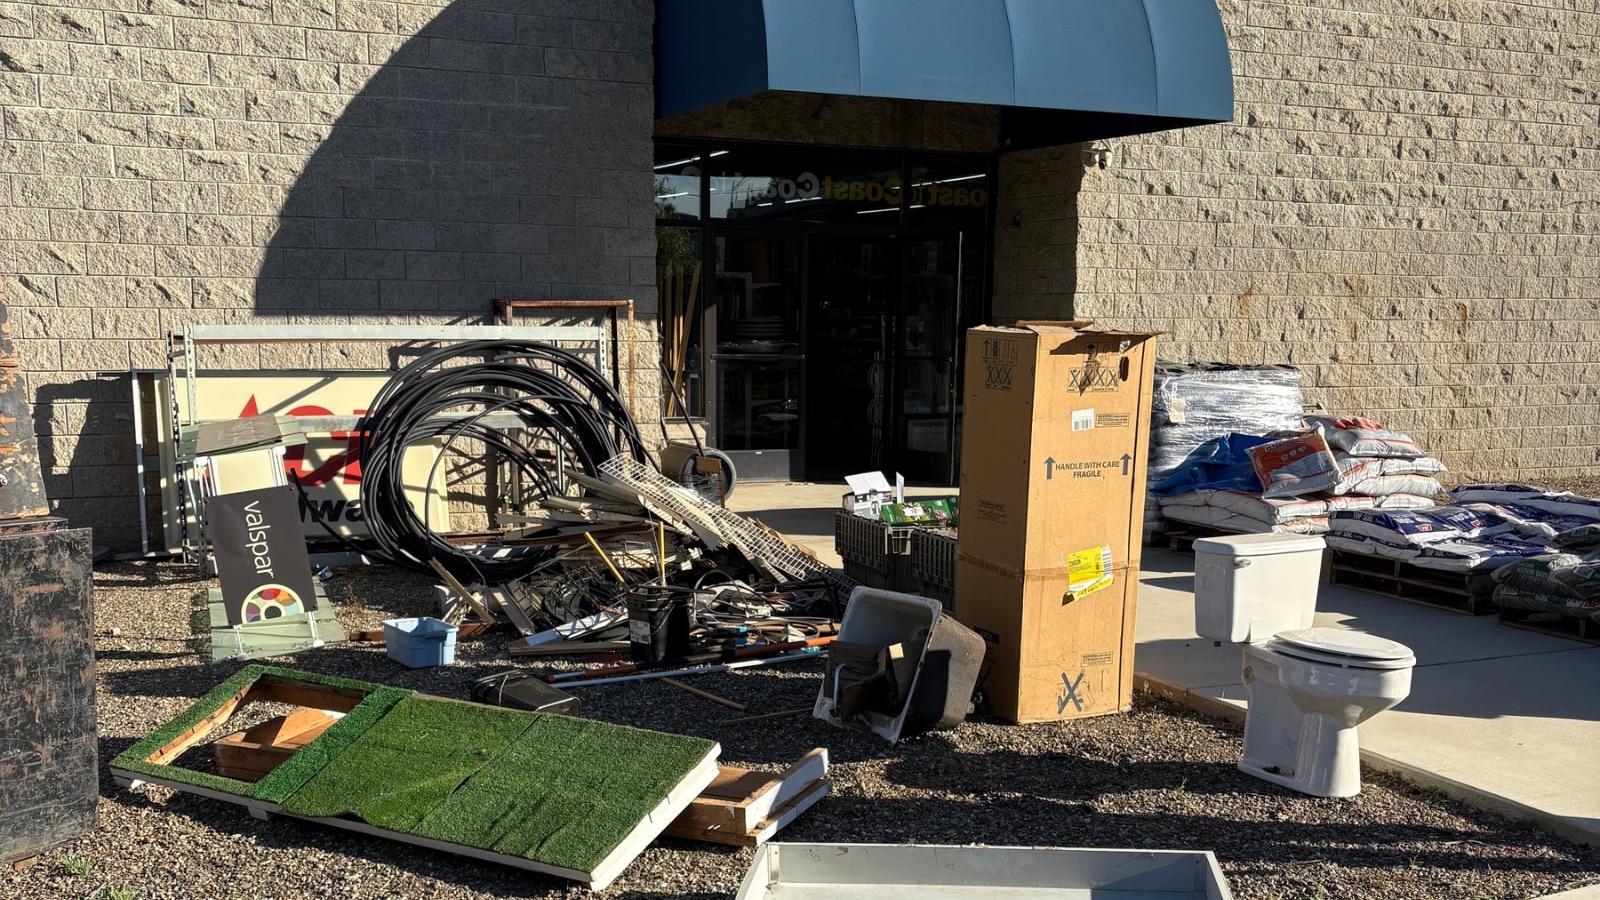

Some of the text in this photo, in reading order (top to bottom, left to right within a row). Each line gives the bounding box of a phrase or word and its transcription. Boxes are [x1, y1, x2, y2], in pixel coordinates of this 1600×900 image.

[1055, 460, 1120, 471] HANDLE WITH CARE
[1073, 470, 1101, 478] FRAGILE
[244, 500, 274, 579] valspar
